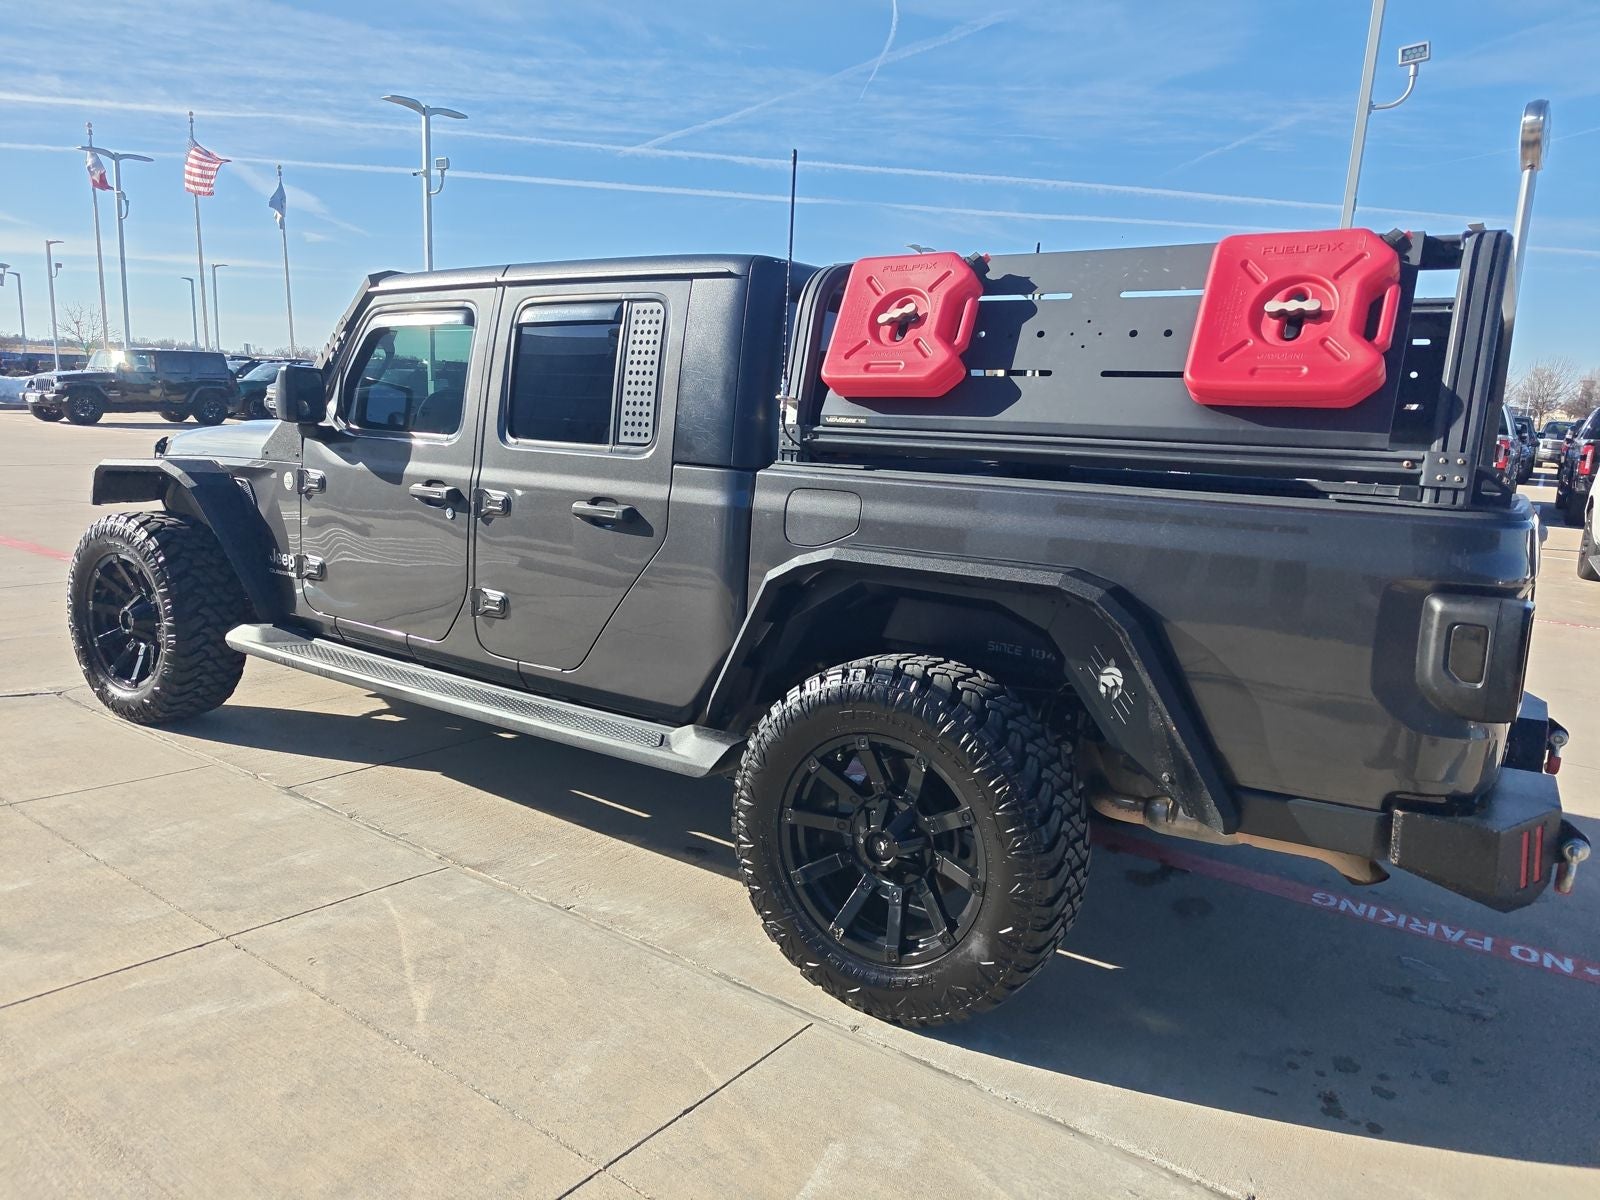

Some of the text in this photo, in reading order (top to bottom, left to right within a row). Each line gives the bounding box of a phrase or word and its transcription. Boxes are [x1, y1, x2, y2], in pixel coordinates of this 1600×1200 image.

[1261, 242, 1345, 256] FUELPAX
[882, 261, 938, 273] FUELPAX
[269, 548, 295, 571] Jeep
[987, 640, 1023, 656] SINCE
[1310, 891, 1575, 975] NO PARKING
